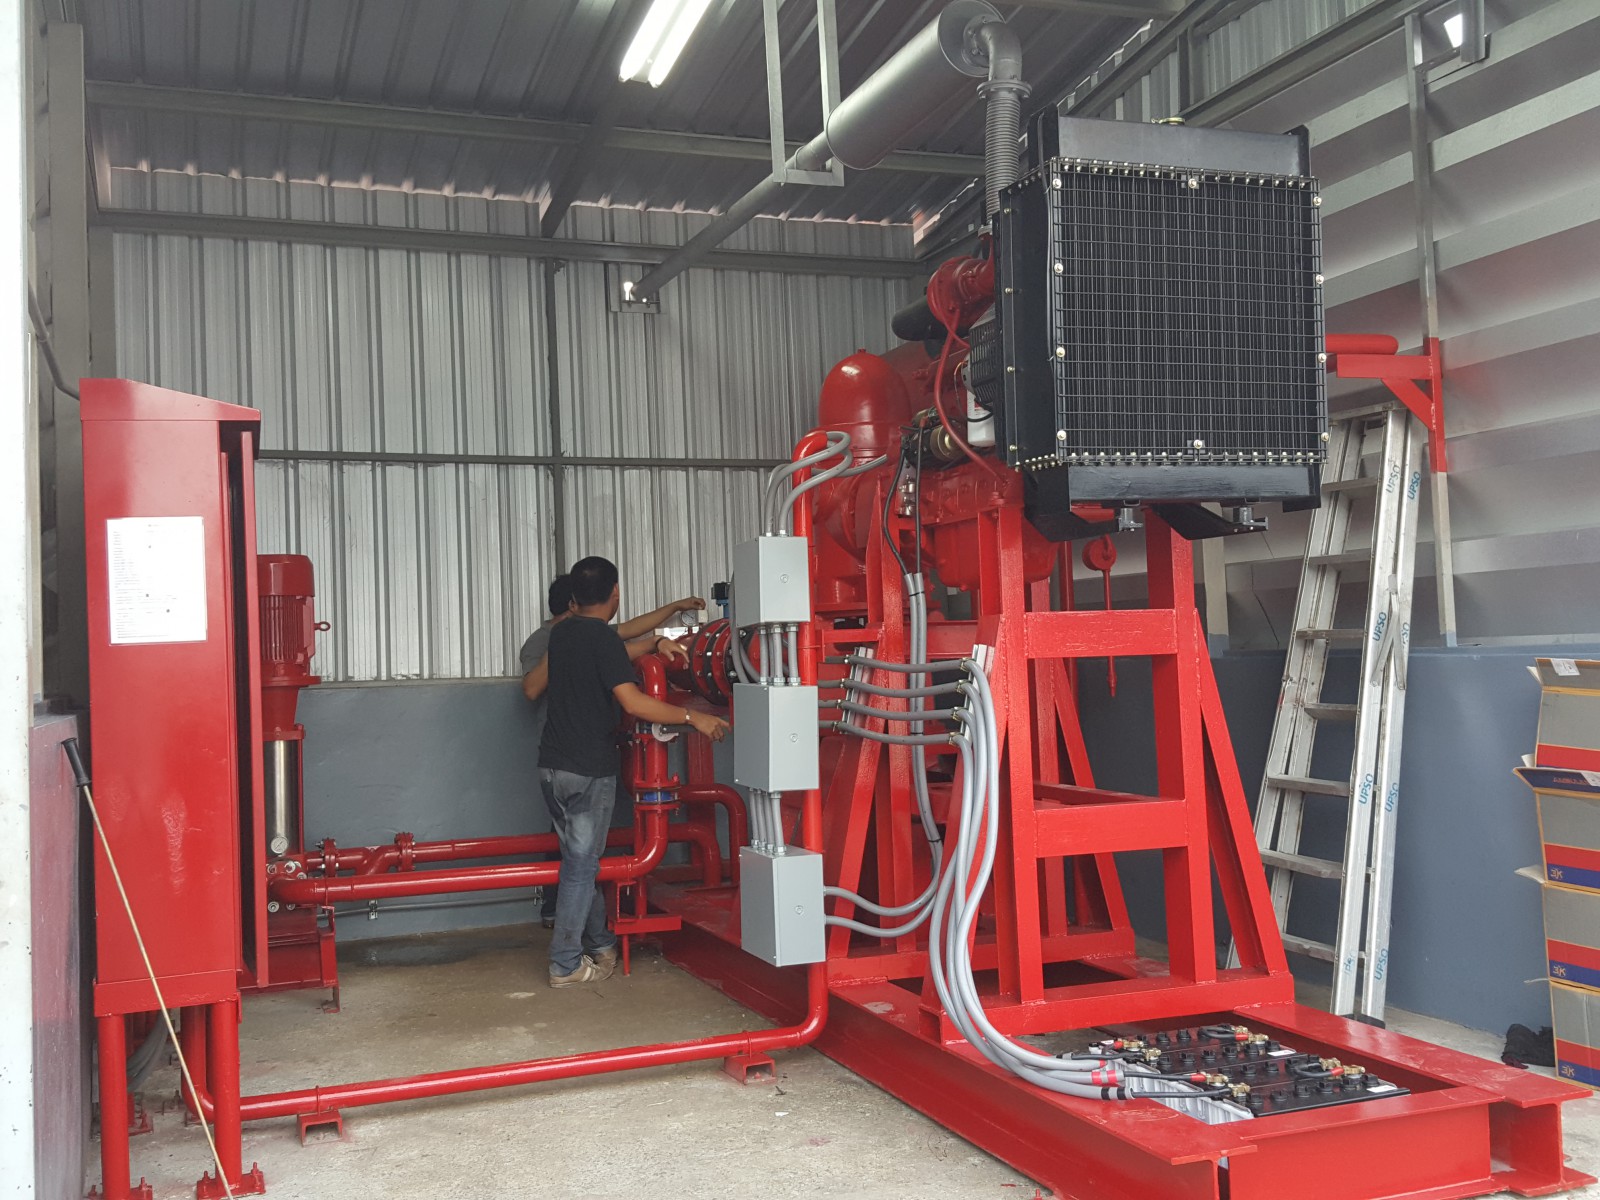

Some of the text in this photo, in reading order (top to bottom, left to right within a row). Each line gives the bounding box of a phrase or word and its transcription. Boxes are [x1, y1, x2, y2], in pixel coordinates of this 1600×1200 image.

[1386, 464, 1401, 493] UPSO
[1407, 471, 1421, 500] UPSO
[1372, 611, 1387, 642] UPSO
[1358, 773, 1373, 805] UPSO
[1384, 782, 1399, 813] UPSO
[1374, 948, 1389, 980] UPSO
